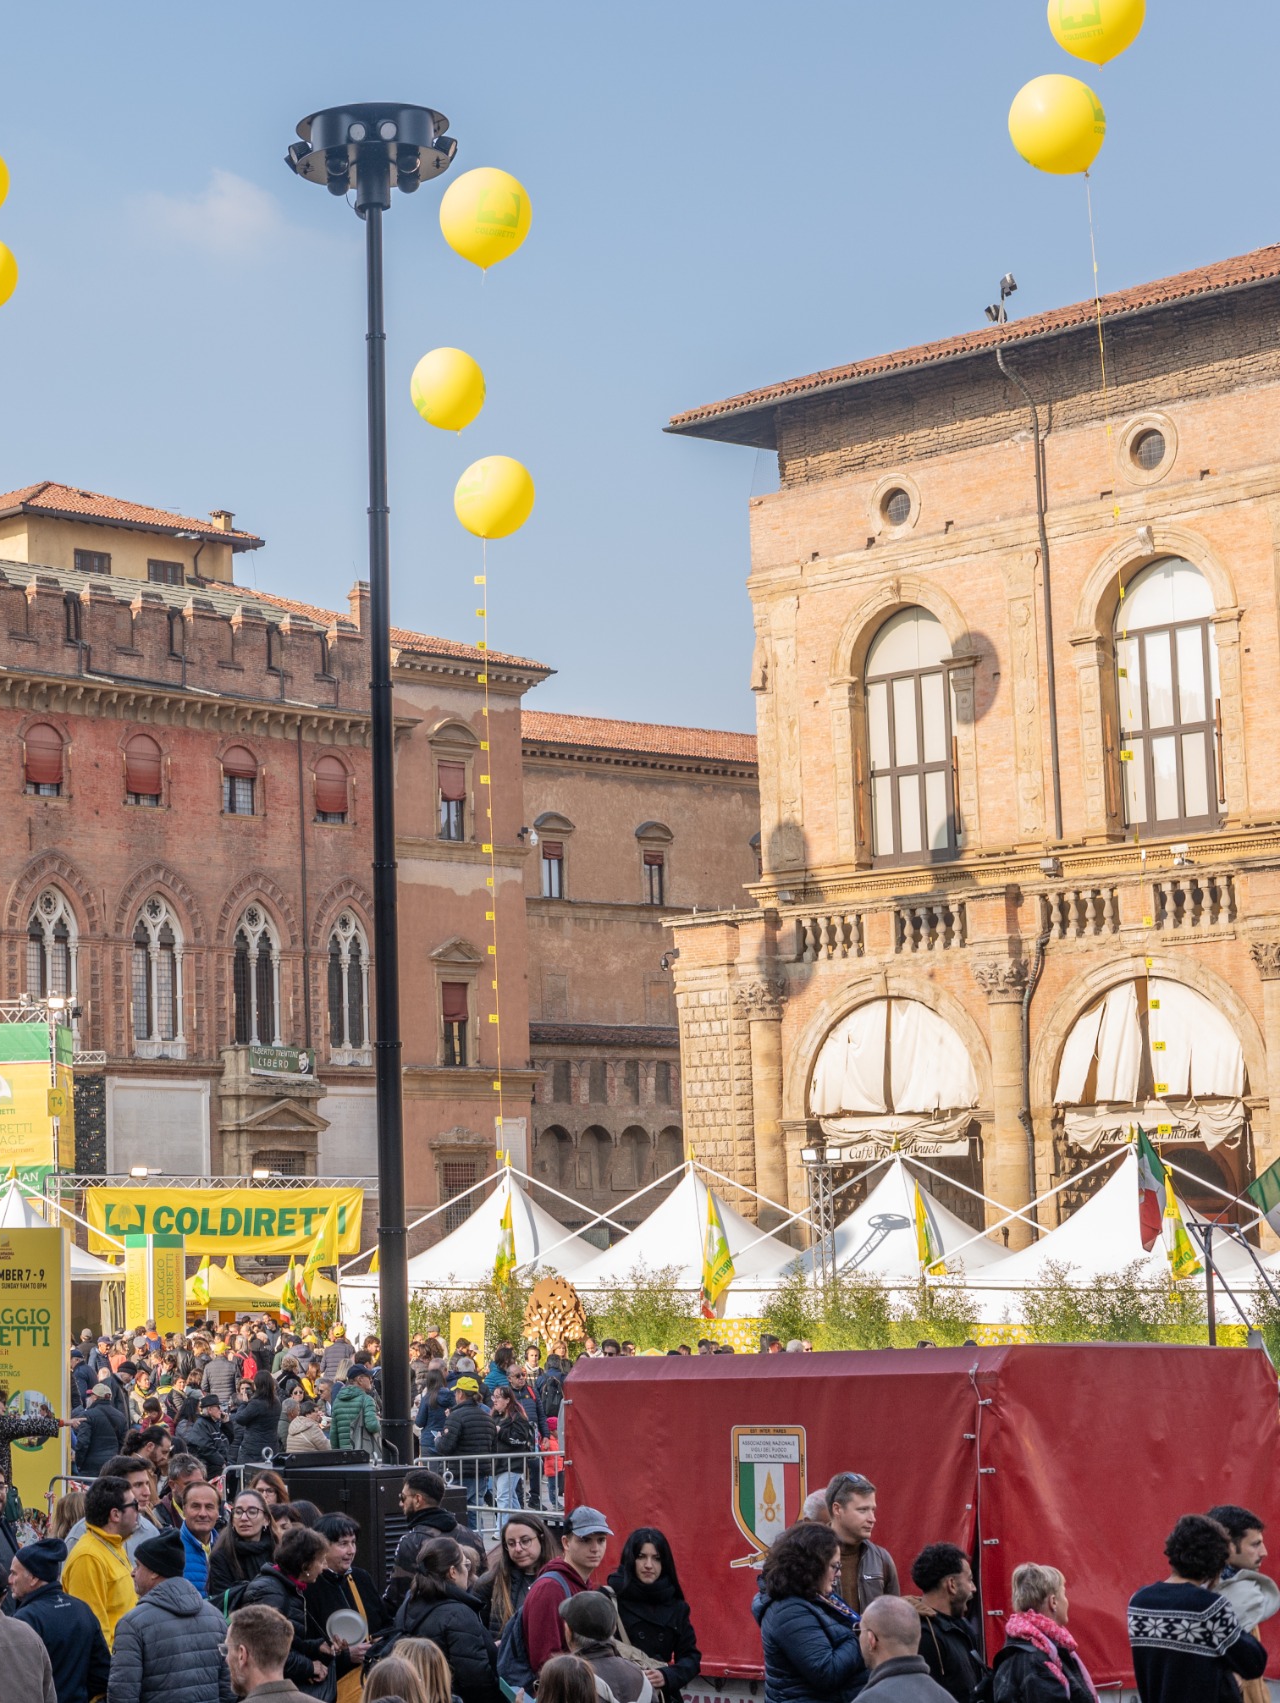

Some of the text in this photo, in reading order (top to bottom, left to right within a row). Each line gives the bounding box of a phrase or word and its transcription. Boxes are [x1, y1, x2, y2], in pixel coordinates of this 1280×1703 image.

[252, 1046, 275, 1056] ALBERTO
[258, 1057, 289, 1069] LIBERO
[51, 1096, 63, 1107] T4
[25, 1269, 31, 1281] 7
[39, 1269, 45, 1281] 9
[157, 1258, 165, 1319] VILLAGGIO
[166, 1253, 174, 1319] COLDIRETTI
